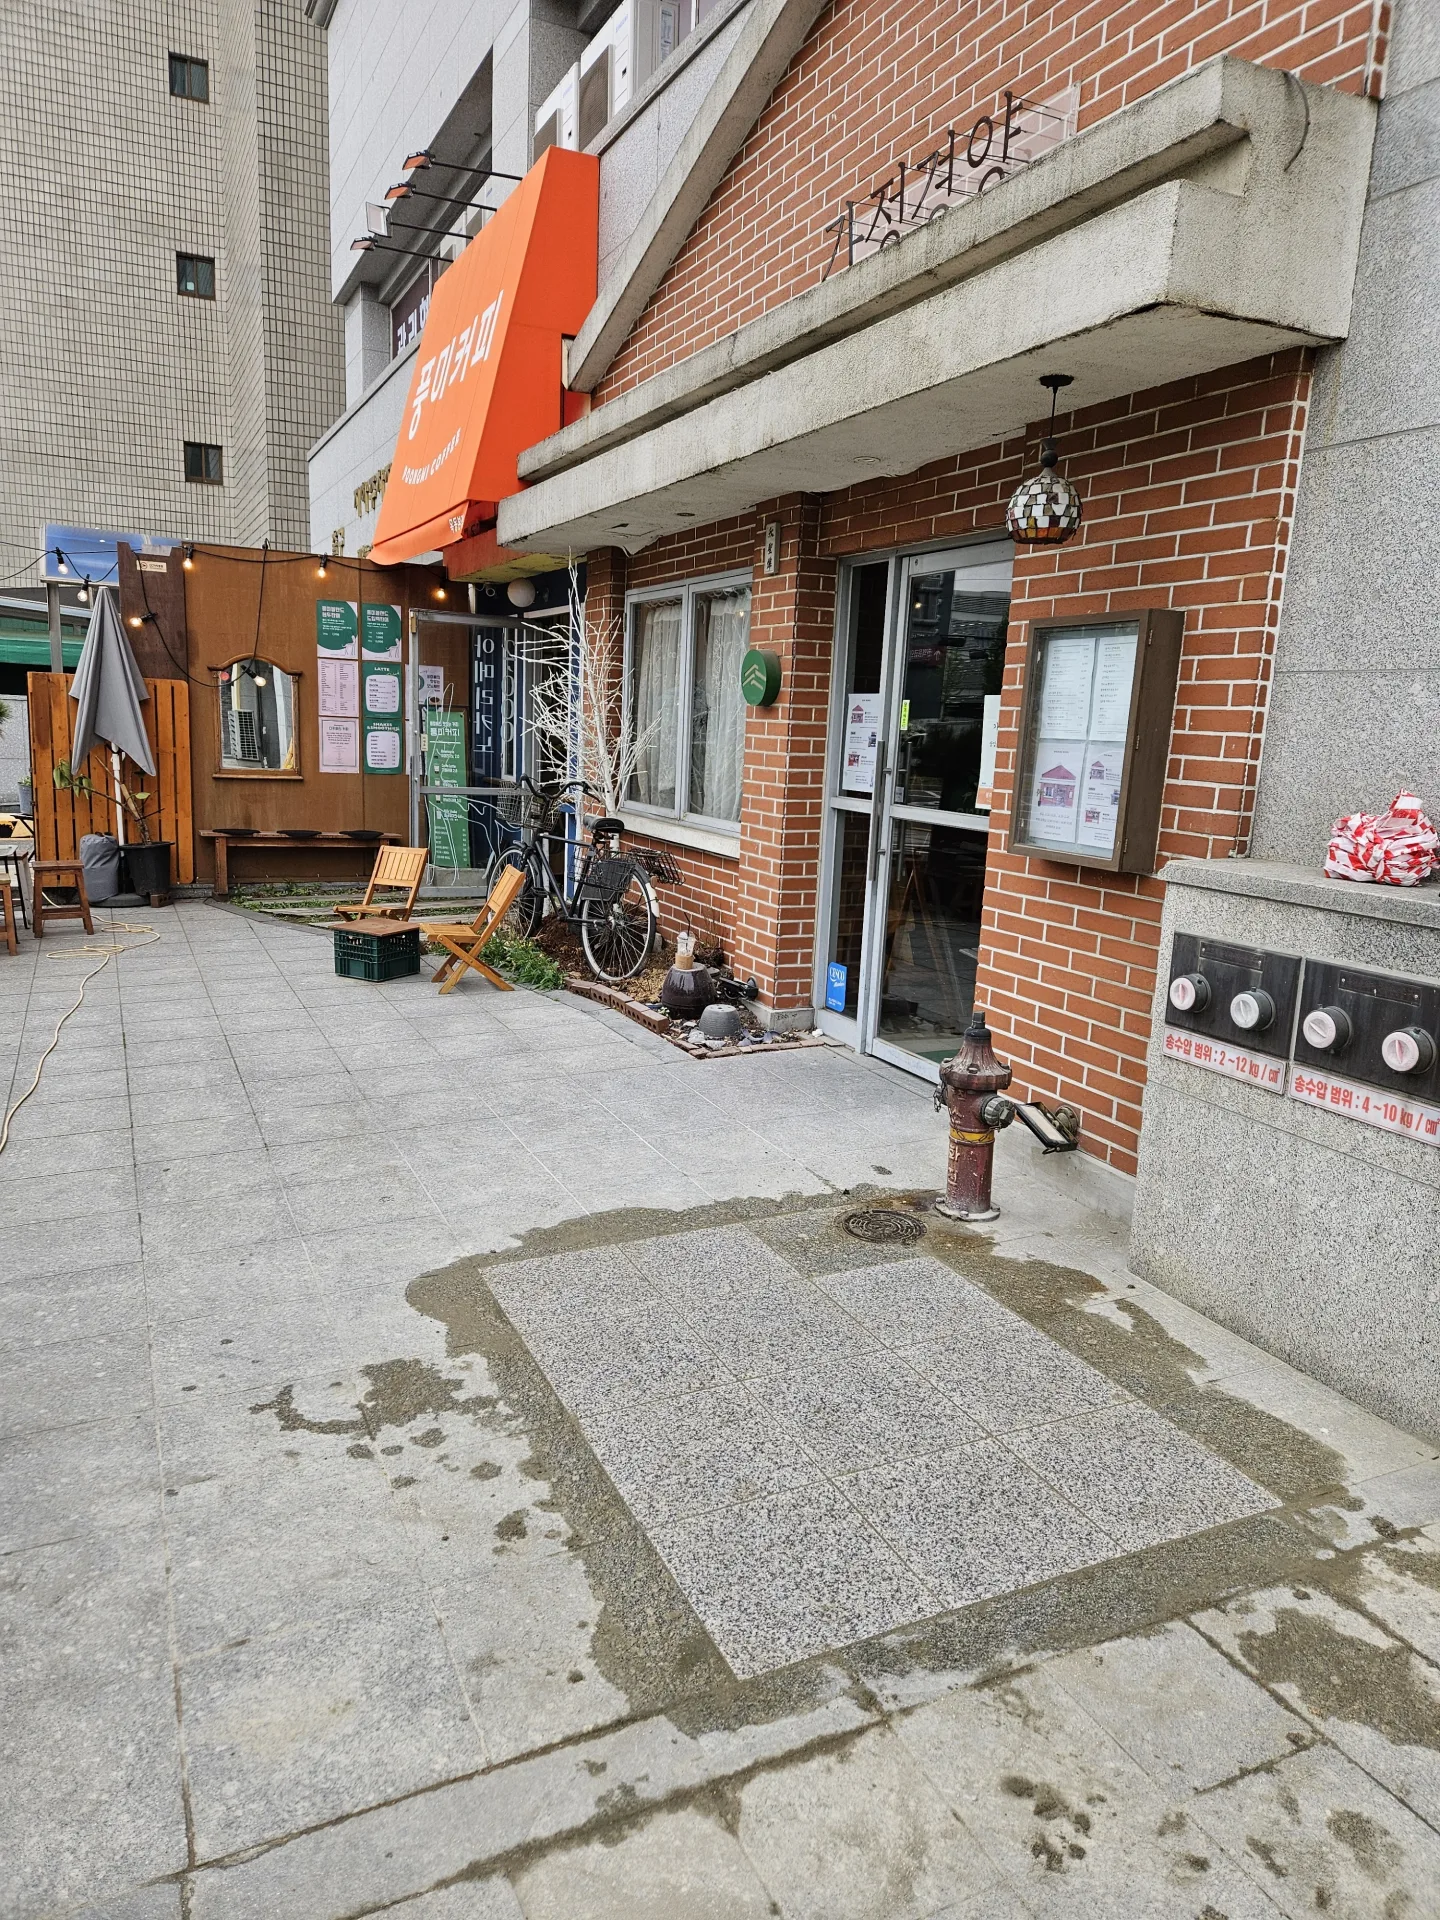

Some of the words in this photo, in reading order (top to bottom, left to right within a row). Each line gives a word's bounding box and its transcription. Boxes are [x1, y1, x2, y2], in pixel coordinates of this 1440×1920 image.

[408, 289, 504, 440] 풍미커피
[430, 427, 461, 476] COFFEE
[430, 727, 460, 737] 풍미커피
[1166, 1033, 1193, 1056] 송수압
[1294, 1075, 1328, 1101] 송수압
